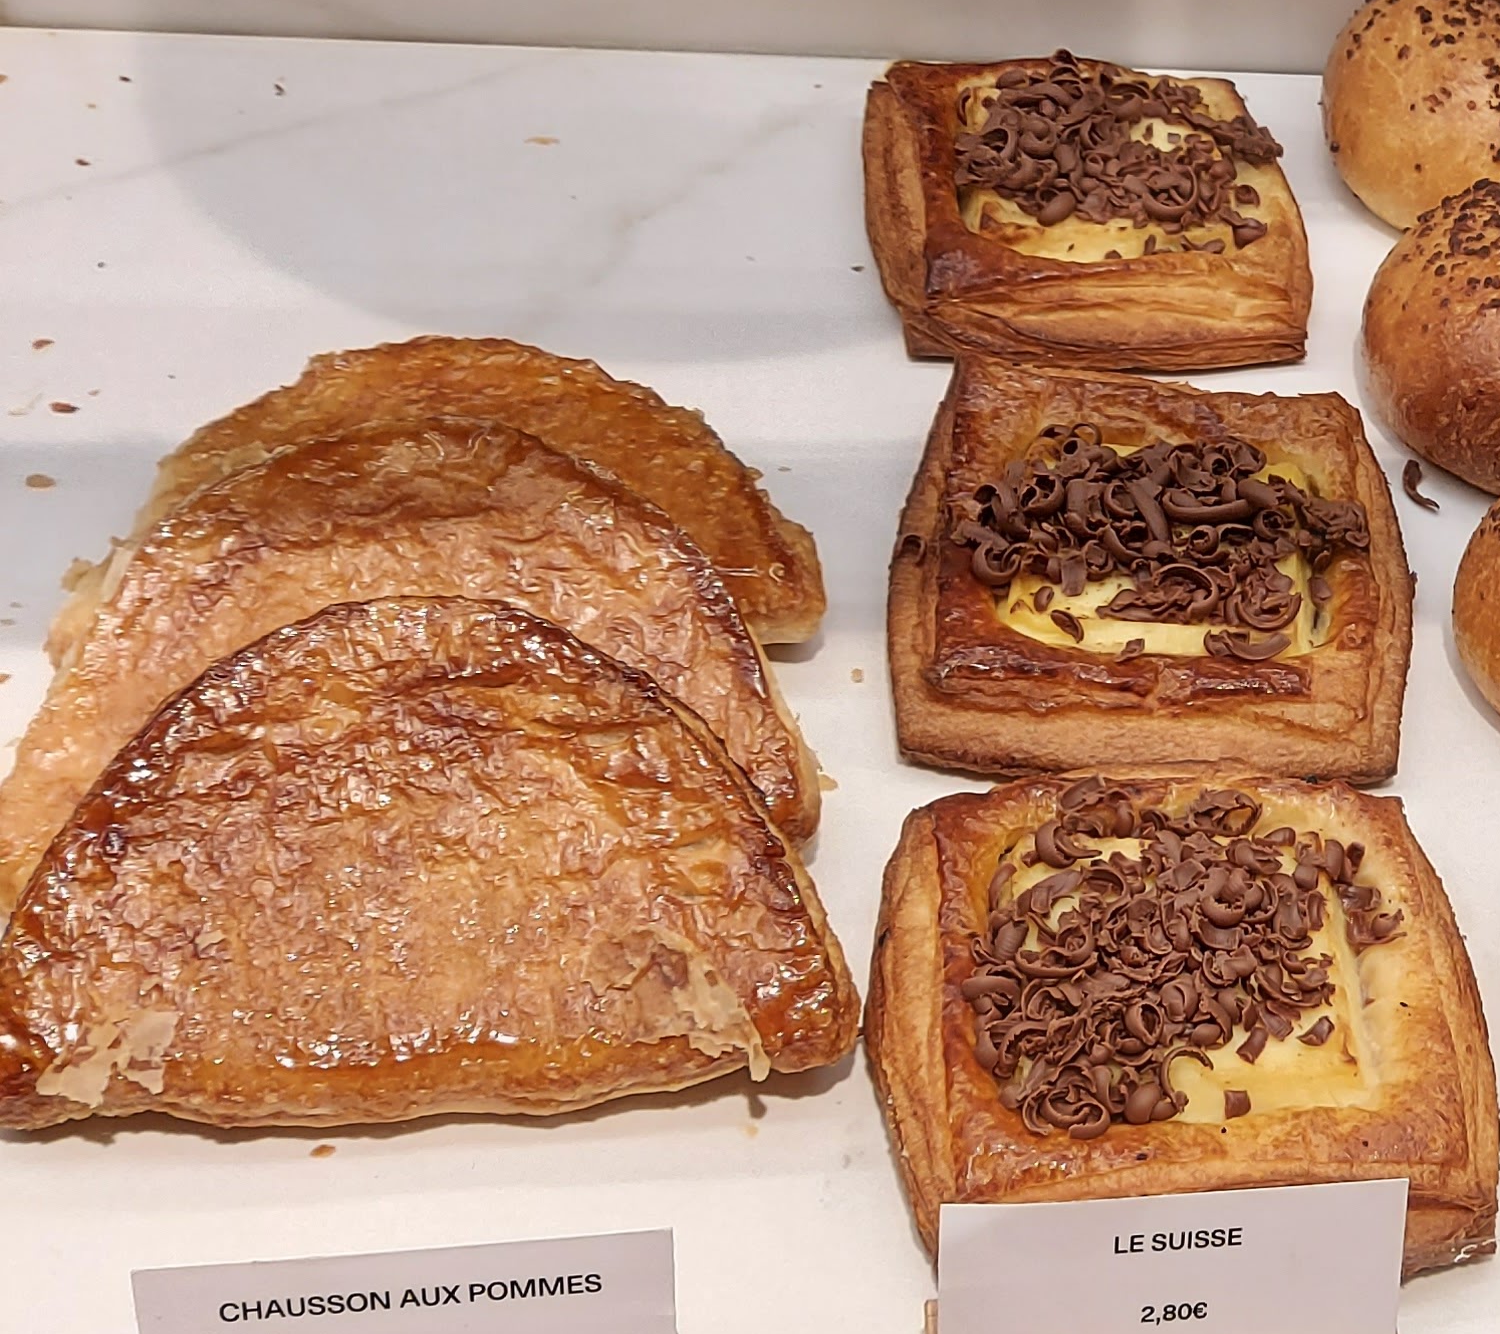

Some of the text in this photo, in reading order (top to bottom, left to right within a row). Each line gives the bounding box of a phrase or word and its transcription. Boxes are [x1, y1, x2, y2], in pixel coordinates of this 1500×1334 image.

[1113, 1227, 1244, 1255] LE SUISSE
[218, 1273, 603, 1323] CHAUSSON AUX POMMES
[1140, 1301, 1209, 1326] 2,80€
